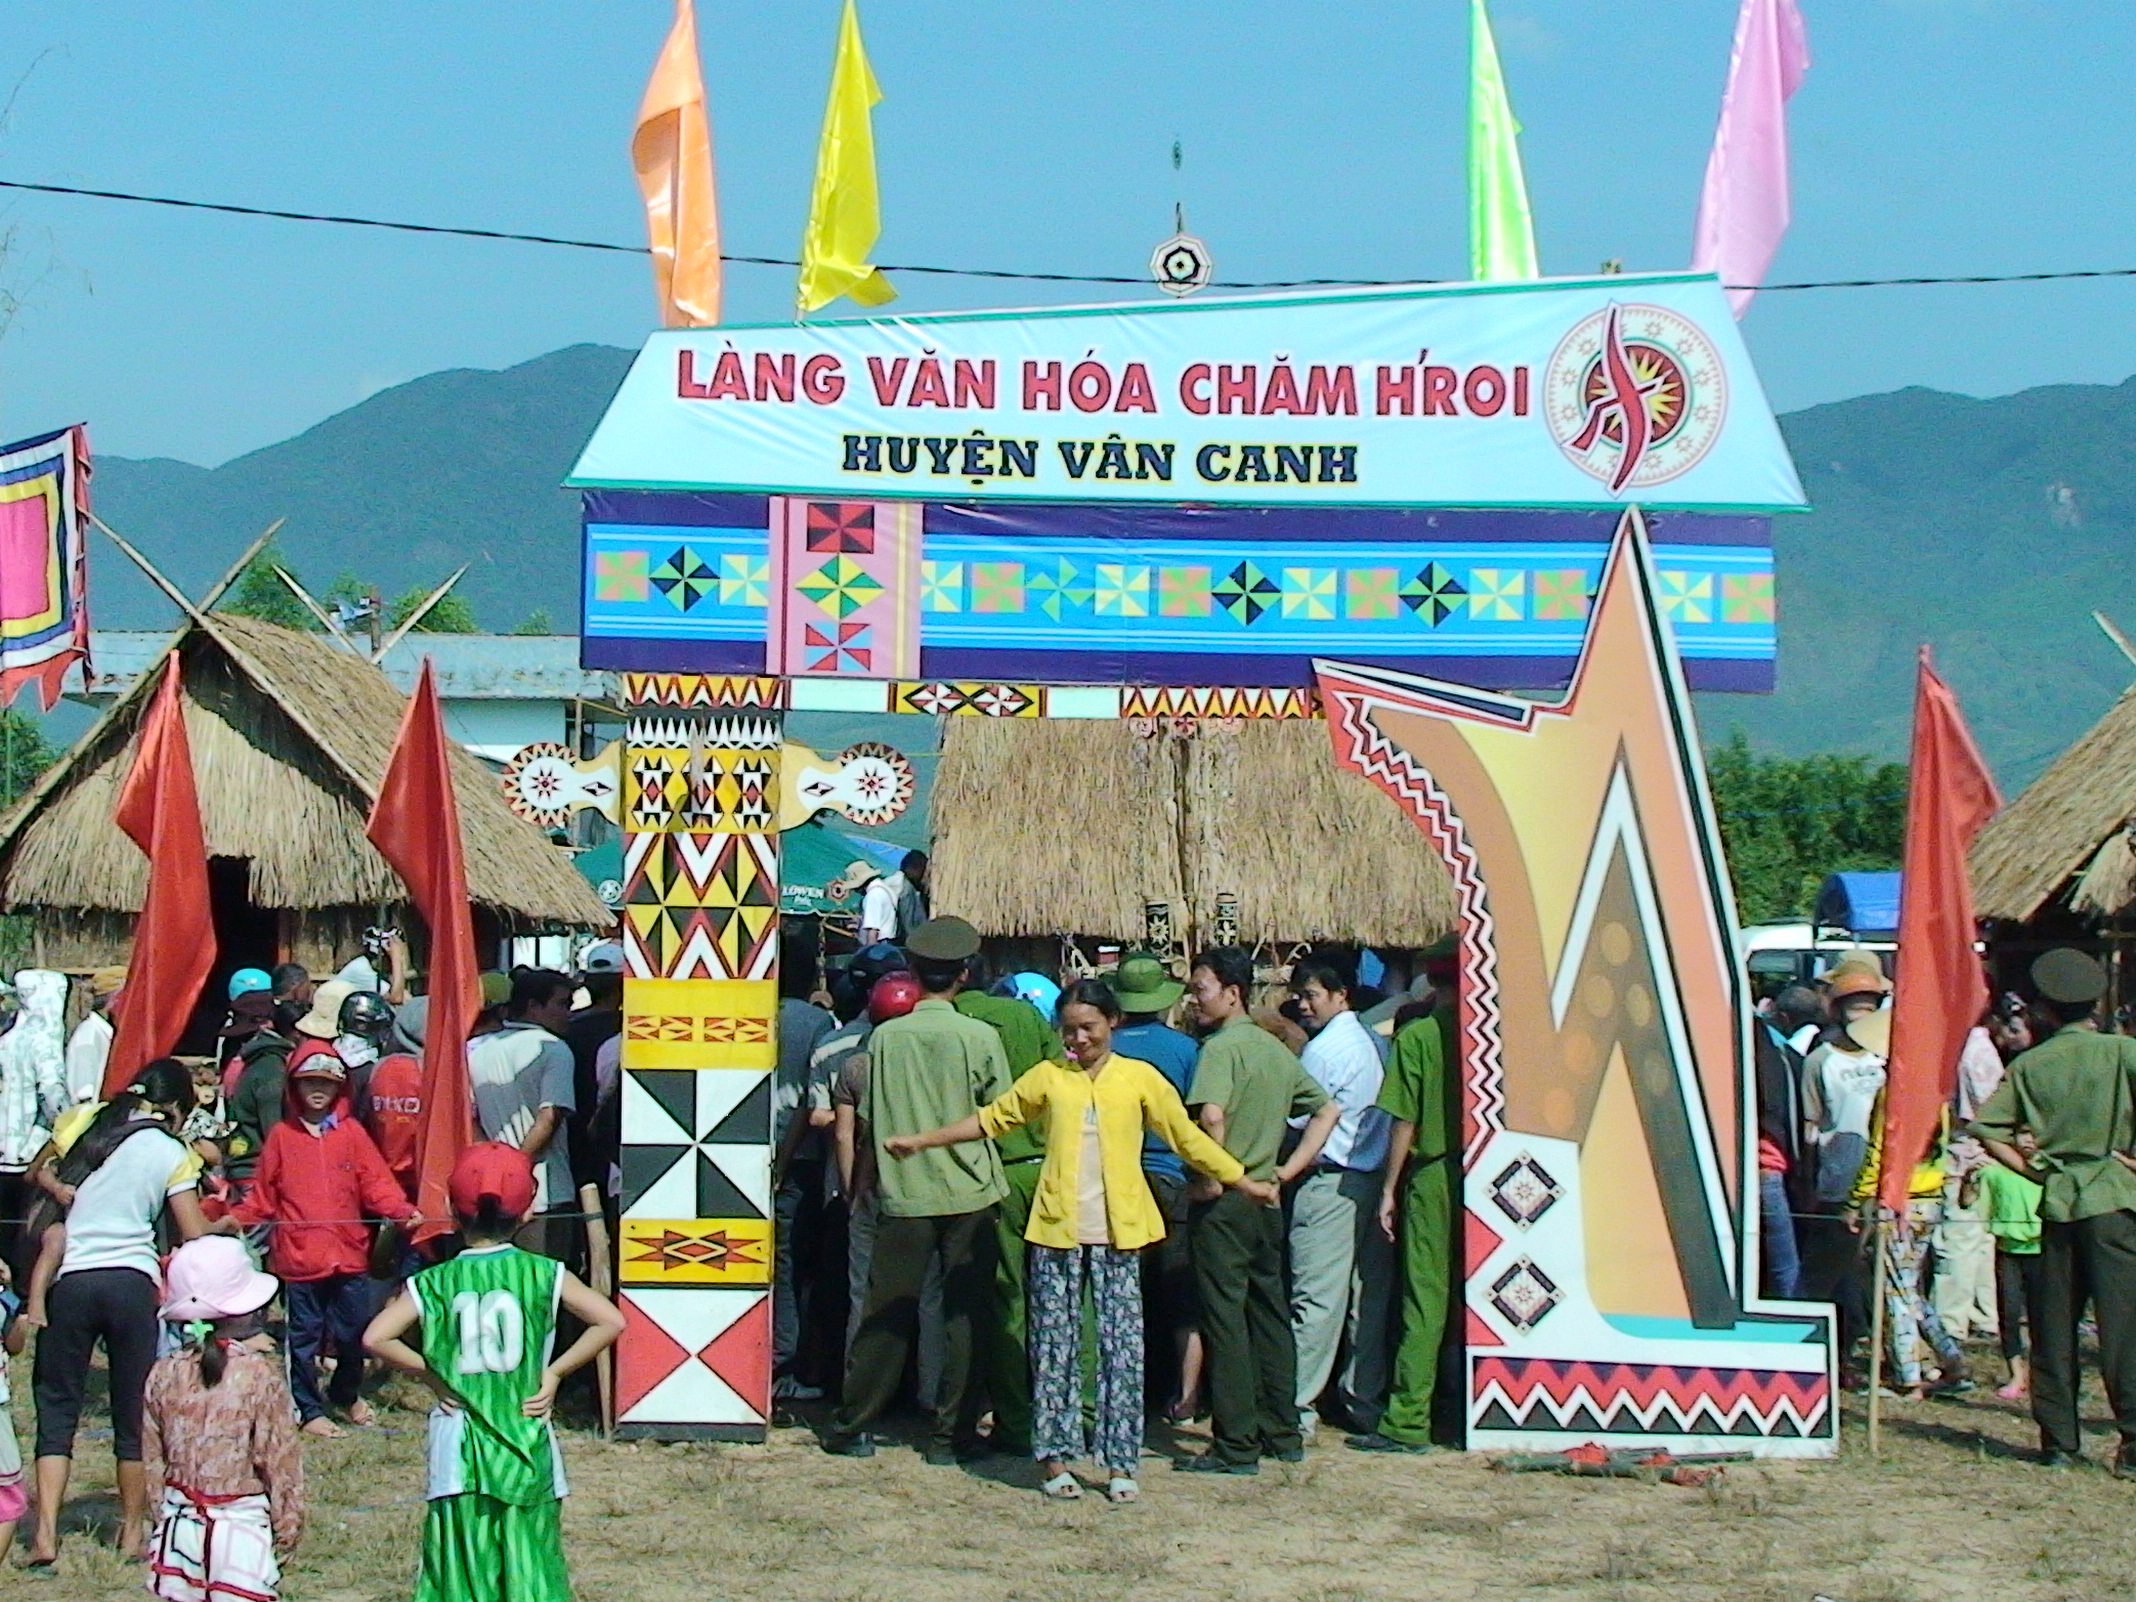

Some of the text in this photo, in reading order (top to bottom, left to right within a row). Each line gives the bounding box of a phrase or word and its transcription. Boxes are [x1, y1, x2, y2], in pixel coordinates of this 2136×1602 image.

[678, 340, 845, 405] LÀNG
[866, 349, 996, 409] VĂN
[1022, 349, 1157, 413] HÓA
[1179, 353, 1359, 416] CHĂM
[842, 430, 1358, 485] HUYỆN VÂN CANH
[452, 1289, 525, 1374] 10
